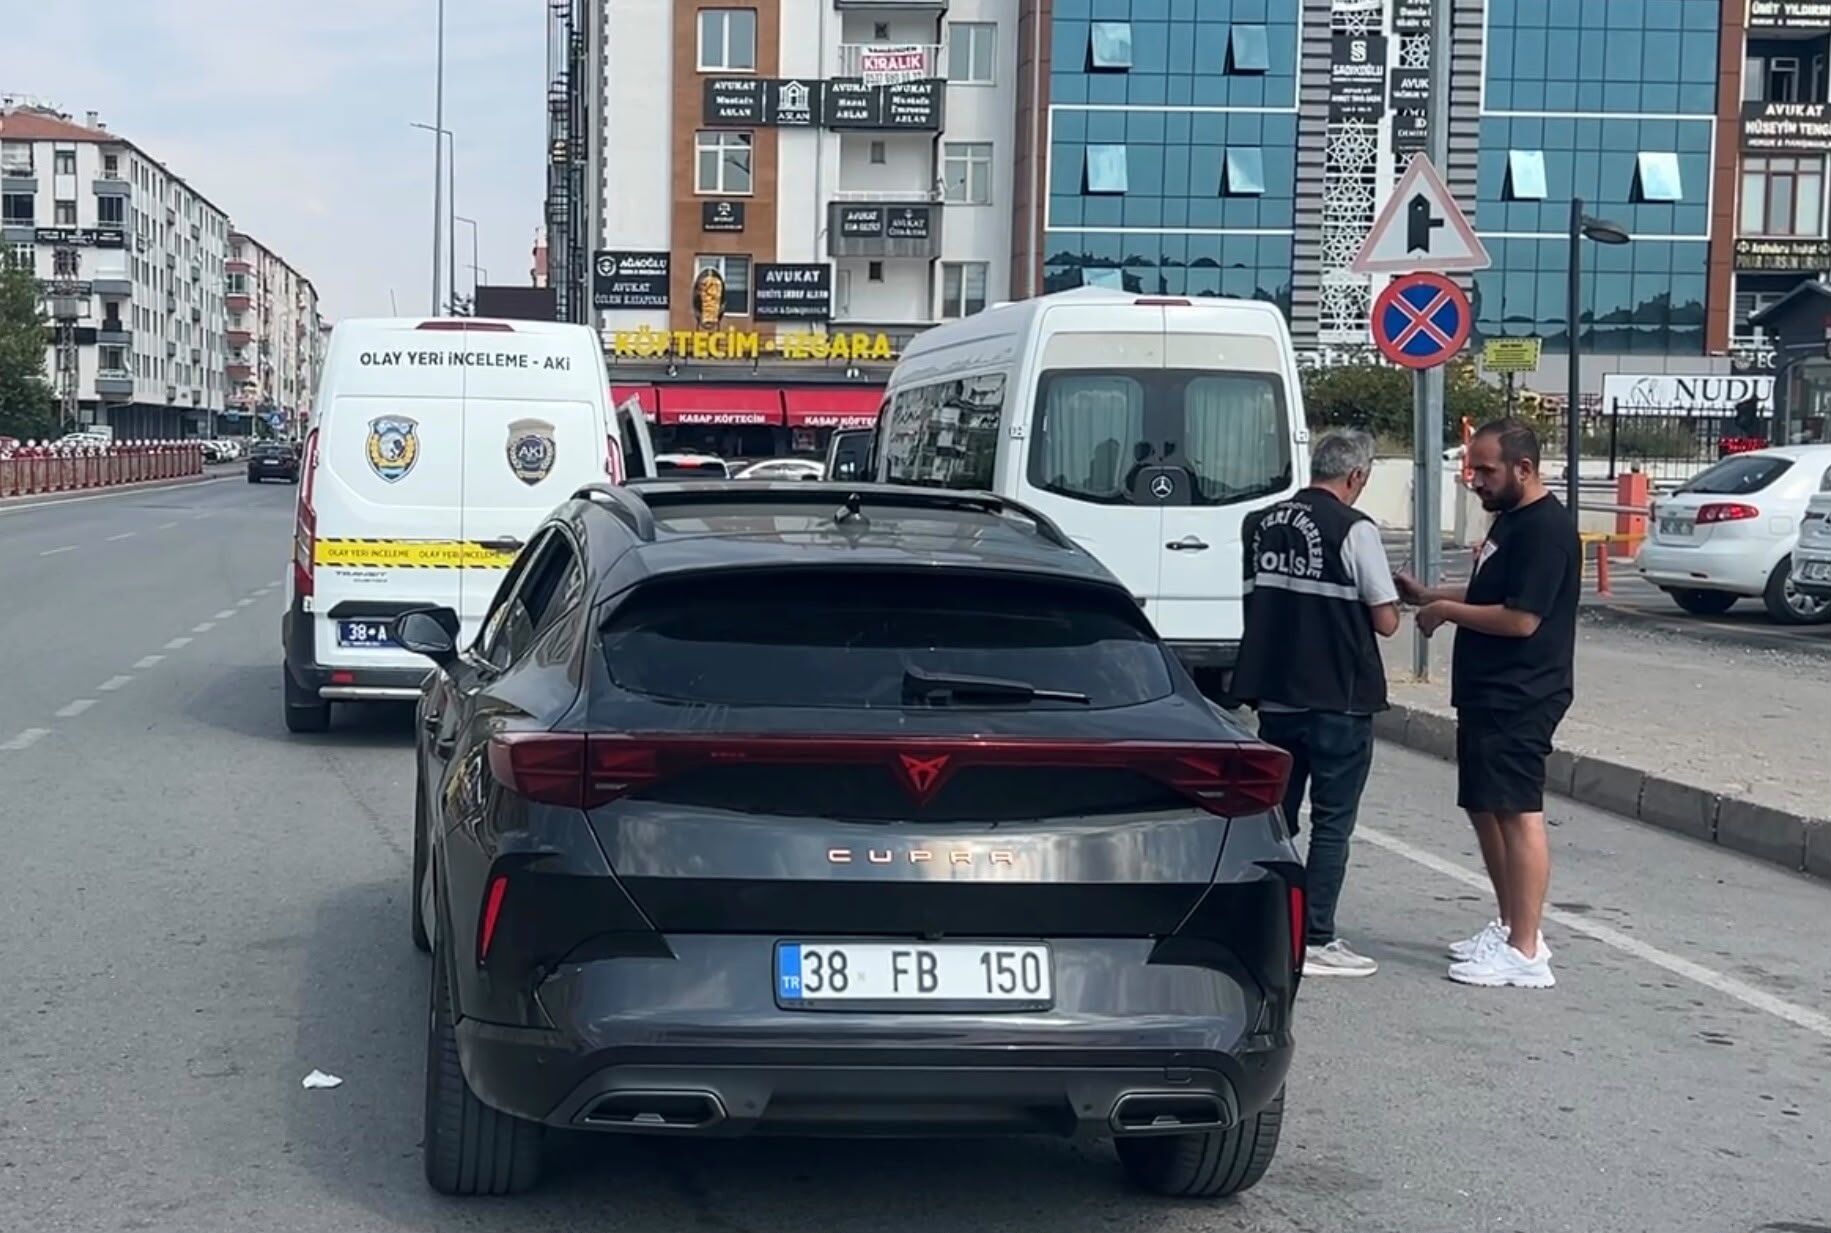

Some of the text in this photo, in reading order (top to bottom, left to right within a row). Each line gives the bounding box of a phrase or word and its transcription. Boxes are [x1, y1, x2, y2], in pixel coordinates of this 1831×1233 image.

[864, 55, 921, 71] KIRALIK
[713, 80, 756, 90] AVUKAT
[890, 84, 931, 94] AVUKAT
[1765, 104, 1824, 117] AVUKAT
[1745, 119, 1796, 135] HÜSEYİN
[766, 270, 820, 282] AVUKAT
[613, 283, 651, 292] AVUKAT
[615, 326, 758, 358] KÖFTECİM
[360, 352, 402, 366] OLAY
[448, 351, 528, 368] İNCELEME
[679, 413, 765, 424] KASAP KÖFTECİM
[804, 416, 838, 425] KASAP
[349, 624, 366, 640] 38
[829, 849, 1012, 865] CUPRA
[783, 950, 1041, 993] TR 38 FB 150
